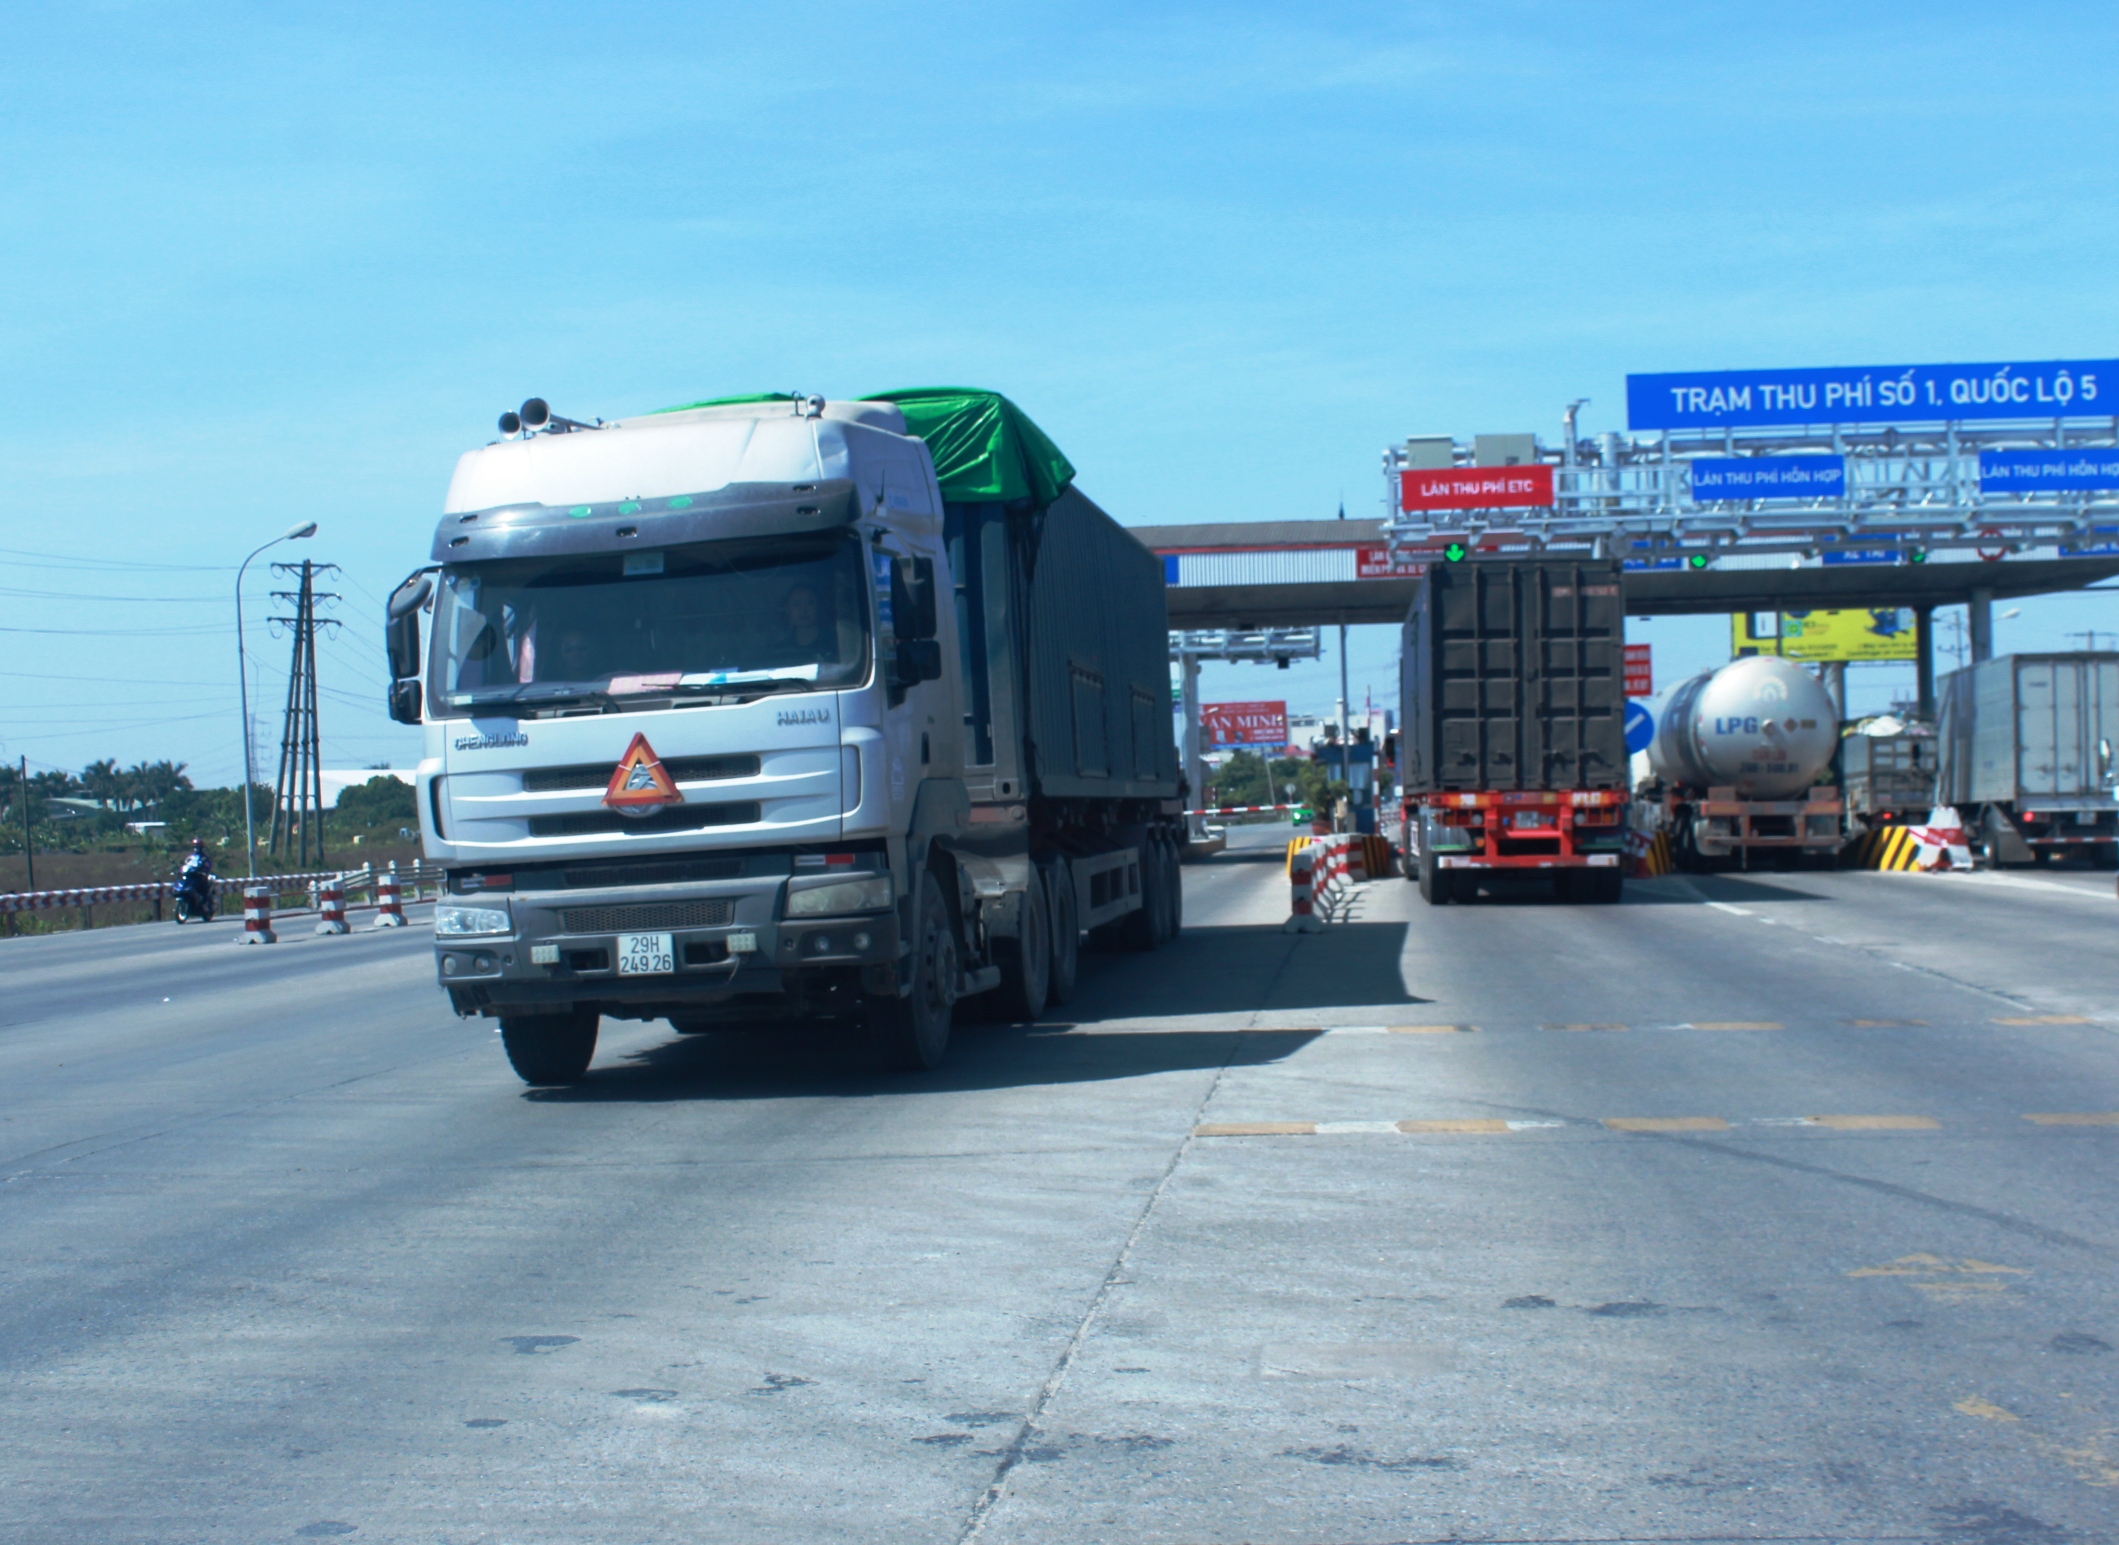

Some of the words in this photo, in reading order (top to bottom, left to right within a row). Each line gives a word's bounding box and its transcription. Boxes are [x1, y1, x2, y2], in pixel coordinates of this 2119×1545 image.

[1671, 386, 1751, 416] TRẠM
[1758, 384, 1817, 410] THU
[1825, 375, 1872, 408] PHÍ
[1878, 368, 1916, 406] SỐ
[1950, 365, 2030, 404] QUỐC
[2036, 369, 2074, 407] LỘ
[2081, 374, 2097, 401] 5
[1725, 471, 1753, 485] THU
[1755, 468, 1778, 484] PHÍ
[2013, 464, 2040, 478] THU
[2042, 461, 2066, 477] PHÍ
[1452, 481, 1480, 495] THU
[1482, 477, 1505, 494] PHÍ
[1507, 479, 1533, 493] ETC
[1715, 717, 1759, 735] LPG
[630, 936, 660, 954] 29H
[620, 953, 672, 973] 249.26
